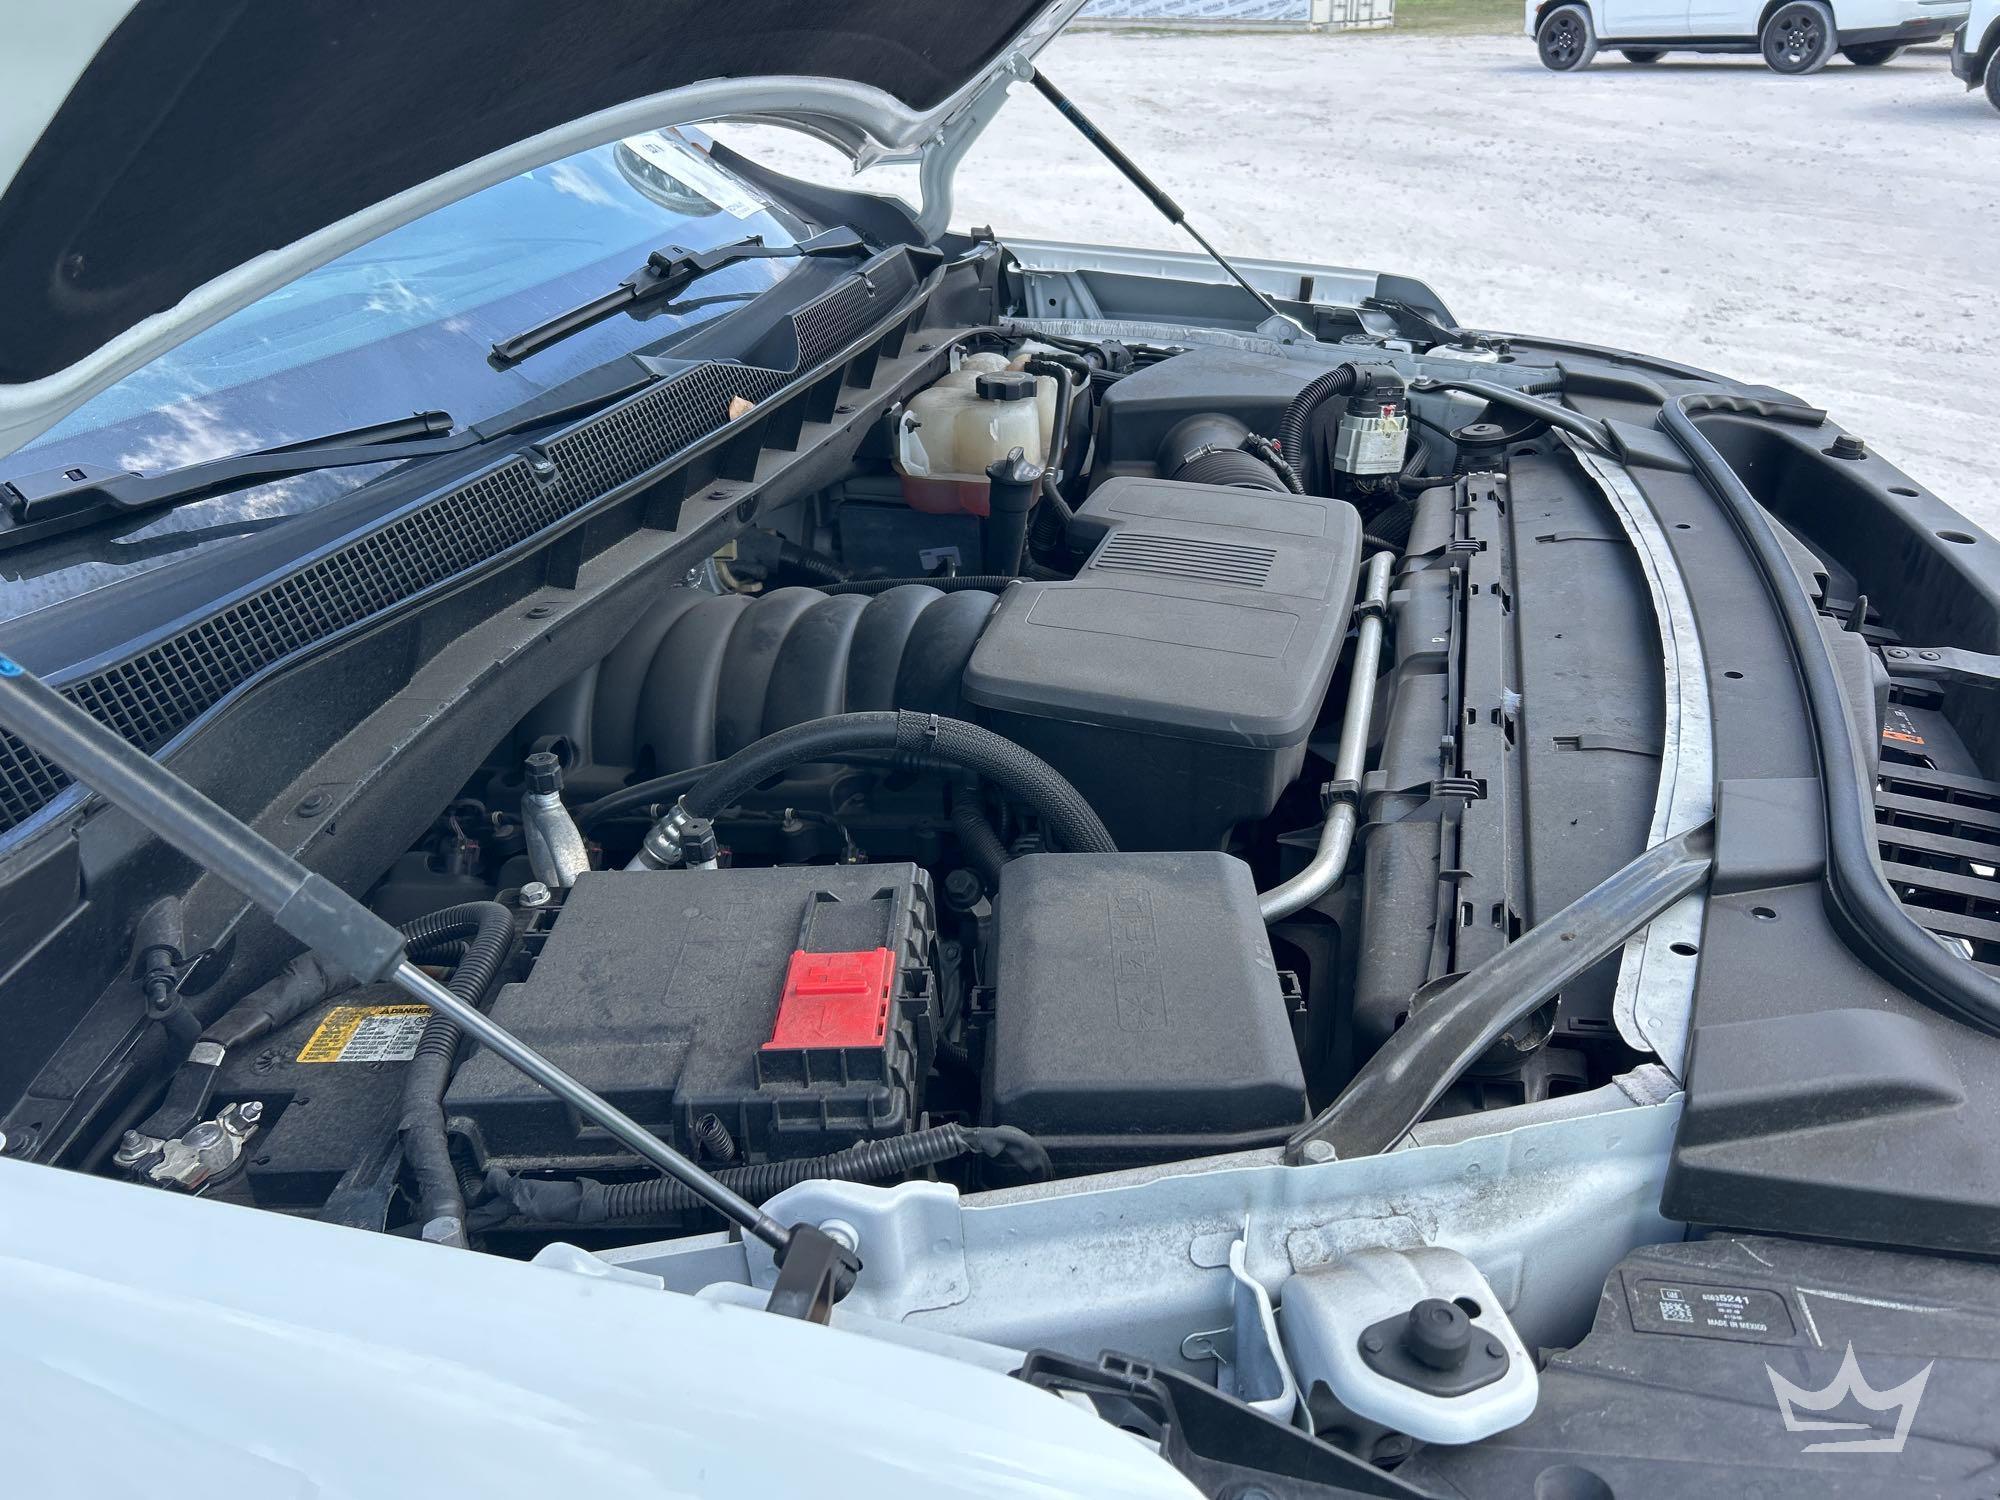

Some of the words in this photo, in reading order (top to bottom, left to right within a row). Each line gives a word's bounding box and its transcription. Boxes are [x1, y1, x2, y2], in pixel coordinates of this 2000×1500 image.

[1707, 1318, 1729, 1327] MADE
[1729, 1321, 1738, 1329] IN
[1739, 1322, 1767, 1332] MEXICO
